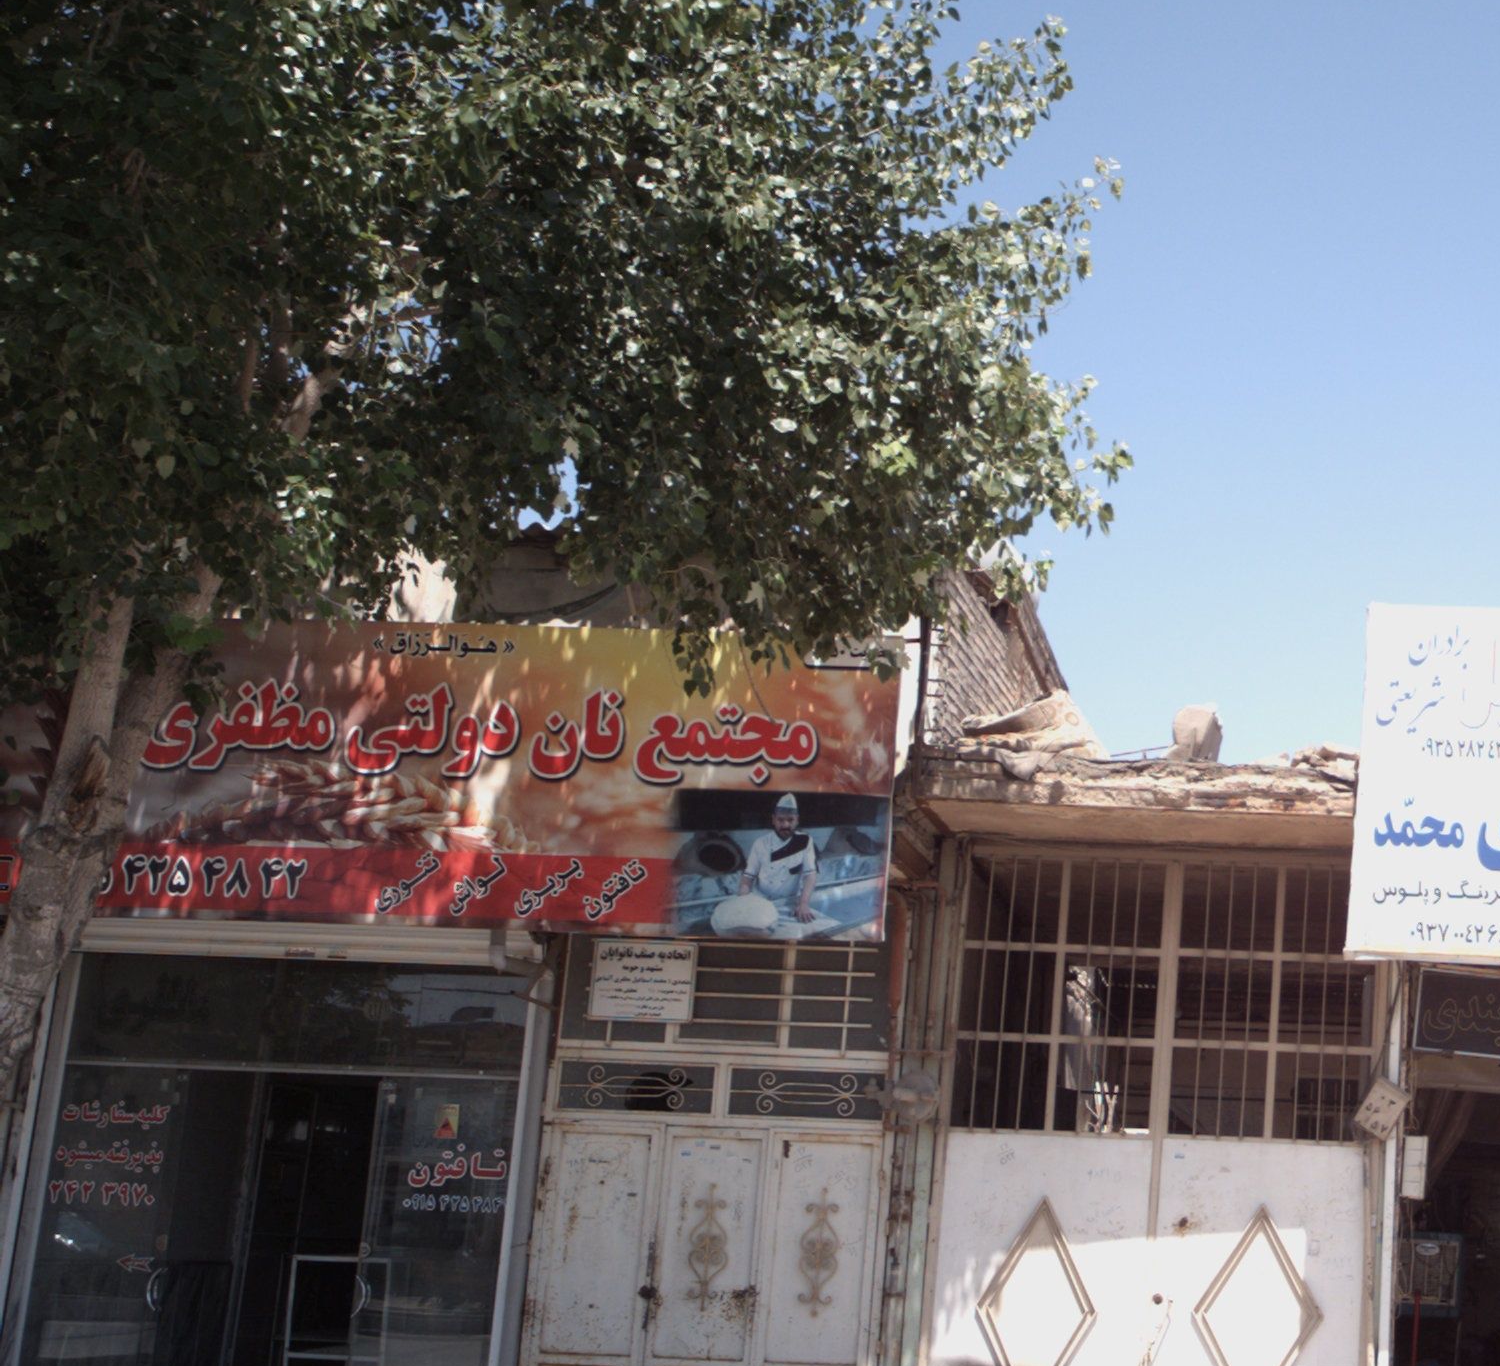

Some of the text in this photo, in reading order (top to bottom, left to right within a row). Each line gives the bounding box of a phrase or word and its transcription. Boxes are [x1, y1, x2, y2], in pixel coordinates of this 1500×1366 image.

[140, 678, 818, 785] مجتمع نان دولتی مظفری
[122, 853, 194, 898] ۴۲۵
[450, 854, 507, 916] لواش
[515, 858, 585, 916] بربری
[583, 859, 648, 922] تافتون
[1372, 880, 1428, 906] پلوس
[1433, 885, 1442, 905] و
[62, 1099, 136, 1128] سفارشات
[407, 1143, 508, 1188] تافتون
